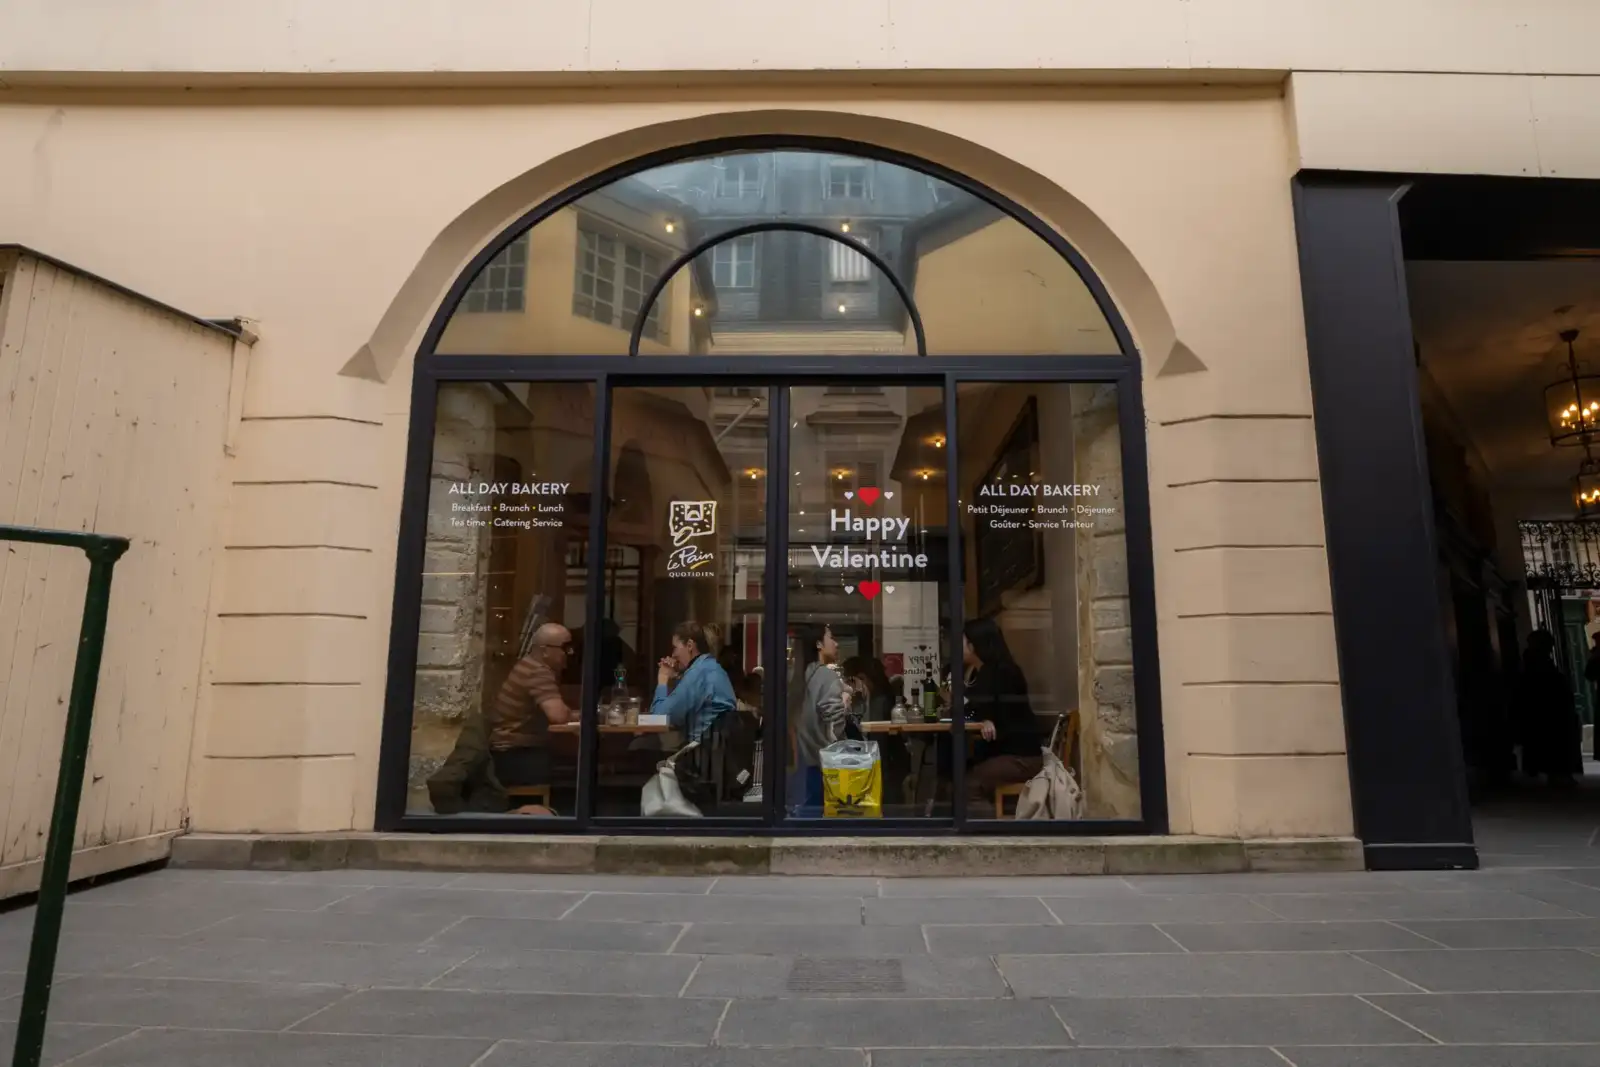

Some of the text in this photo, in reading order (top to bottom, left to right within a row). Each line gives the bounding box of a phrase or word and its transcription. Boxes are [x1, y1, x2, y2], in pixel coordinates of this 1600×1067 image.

[448, 482, 571, 495] ALL DAY BAKERY
[980, 484, 1101, 496] ALL DAY BAKERY
[451, 503, 564, 512] Breakfast Brunch Lunch
[967, 504, 1116, 517] Petit Déjeuner Brunch Déjeuner
[451, 518, 563, 530] Tea time Catering Service
[830, 508, 911, 540] Happy
[990, 519, 1095, 529] Goûter Service Traiteur
[670, 545, 714, 567] Pain
[811, 545, 928, 568] Valentine
[668, 571, 715, 579] QUOTIDIEN
